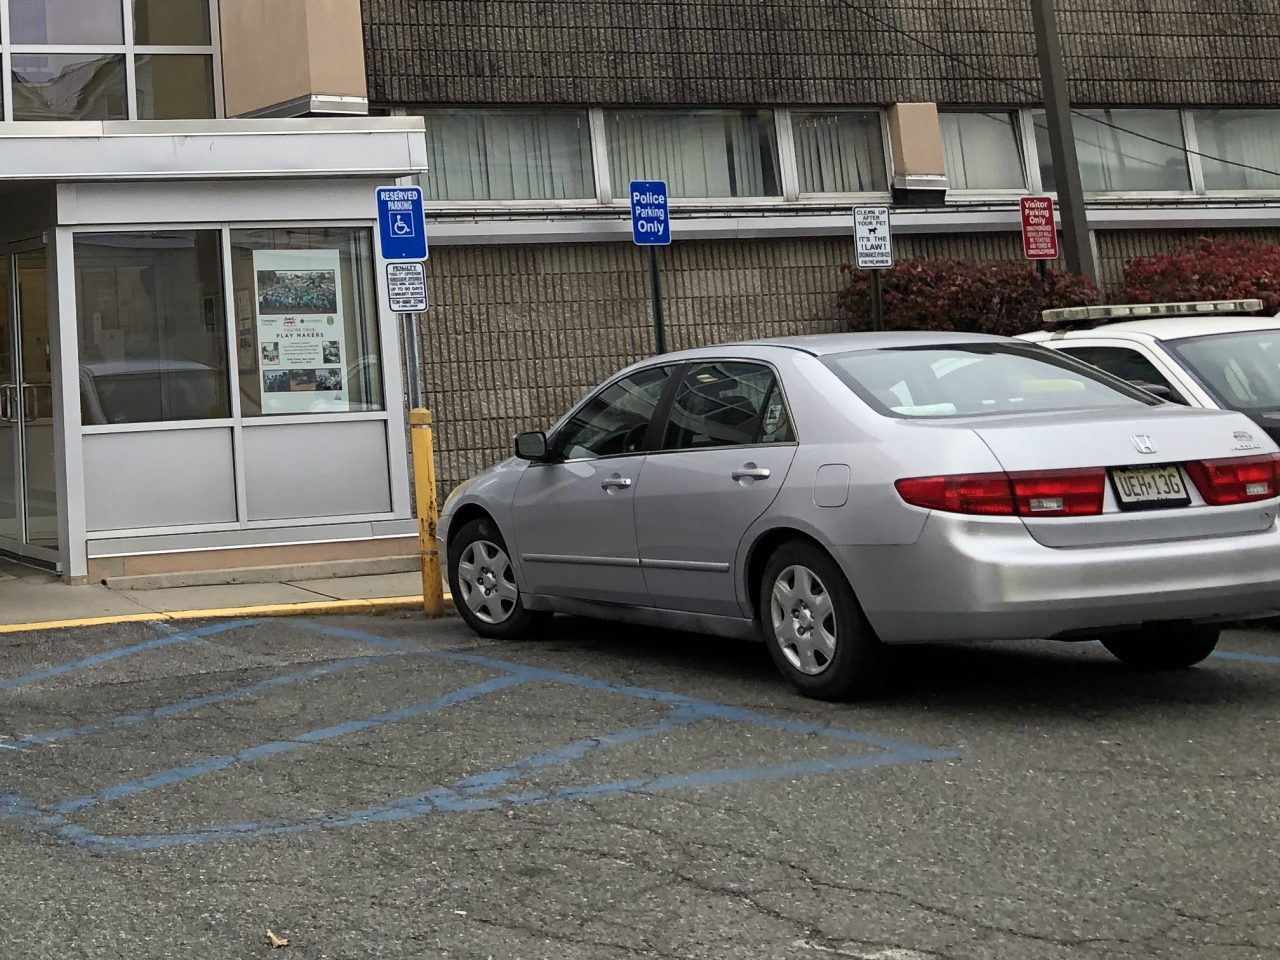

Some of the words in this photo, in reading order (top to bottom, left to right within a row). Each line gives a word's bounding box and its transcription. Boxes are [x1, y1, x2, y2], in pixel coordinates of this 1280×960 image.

[381, 191, 418, 200] RESERVED
[633, 192, 665, 204] Police
[388, 201, 412, 210] PARKING
[636, 206, 664, 220] Parking
[1024, 209, 1049, 218] Parking
[1030, 216, 1046, 226] Only
[638, 220, 664, 236] Only
